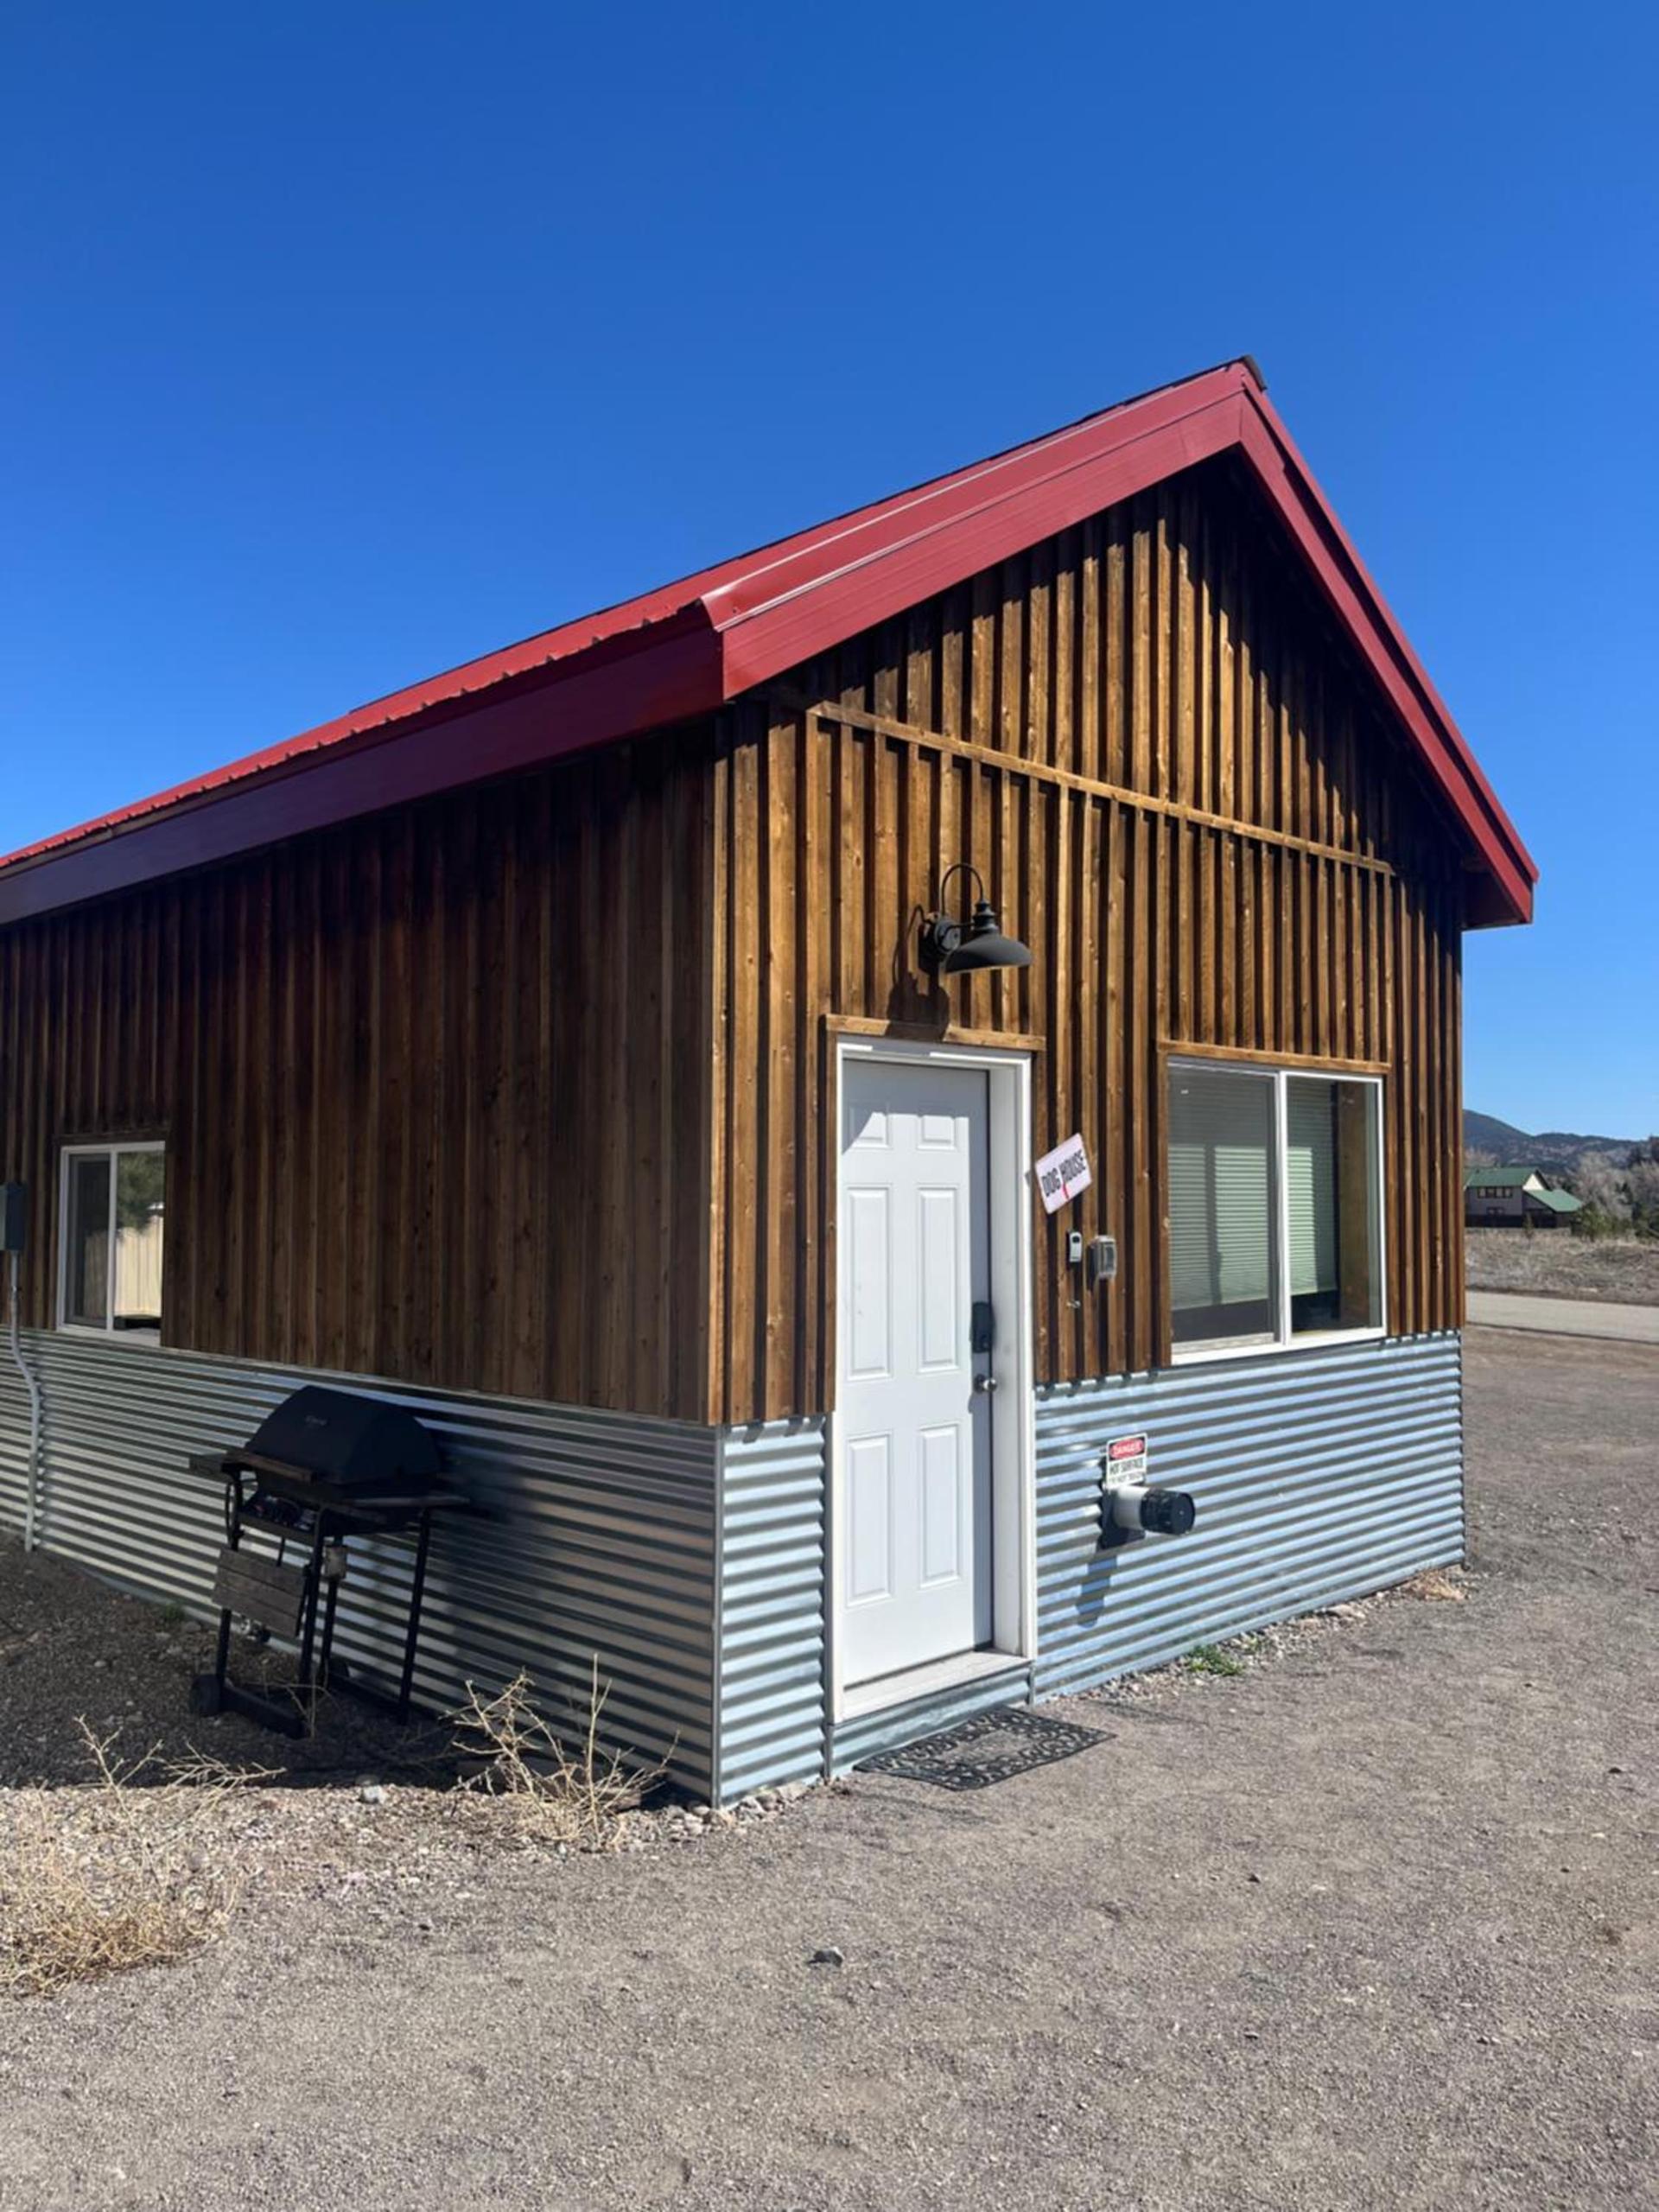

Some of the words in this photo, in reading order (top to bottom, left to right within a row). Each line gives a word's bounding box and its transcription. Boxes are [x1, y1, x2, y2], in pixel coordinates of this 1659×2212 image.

[1041, 1167, 1061, 1198] DOG
[1058, 1148, 1086, 1182] HOUSE
[1112, 1442, 1142, 1456] DANGER
